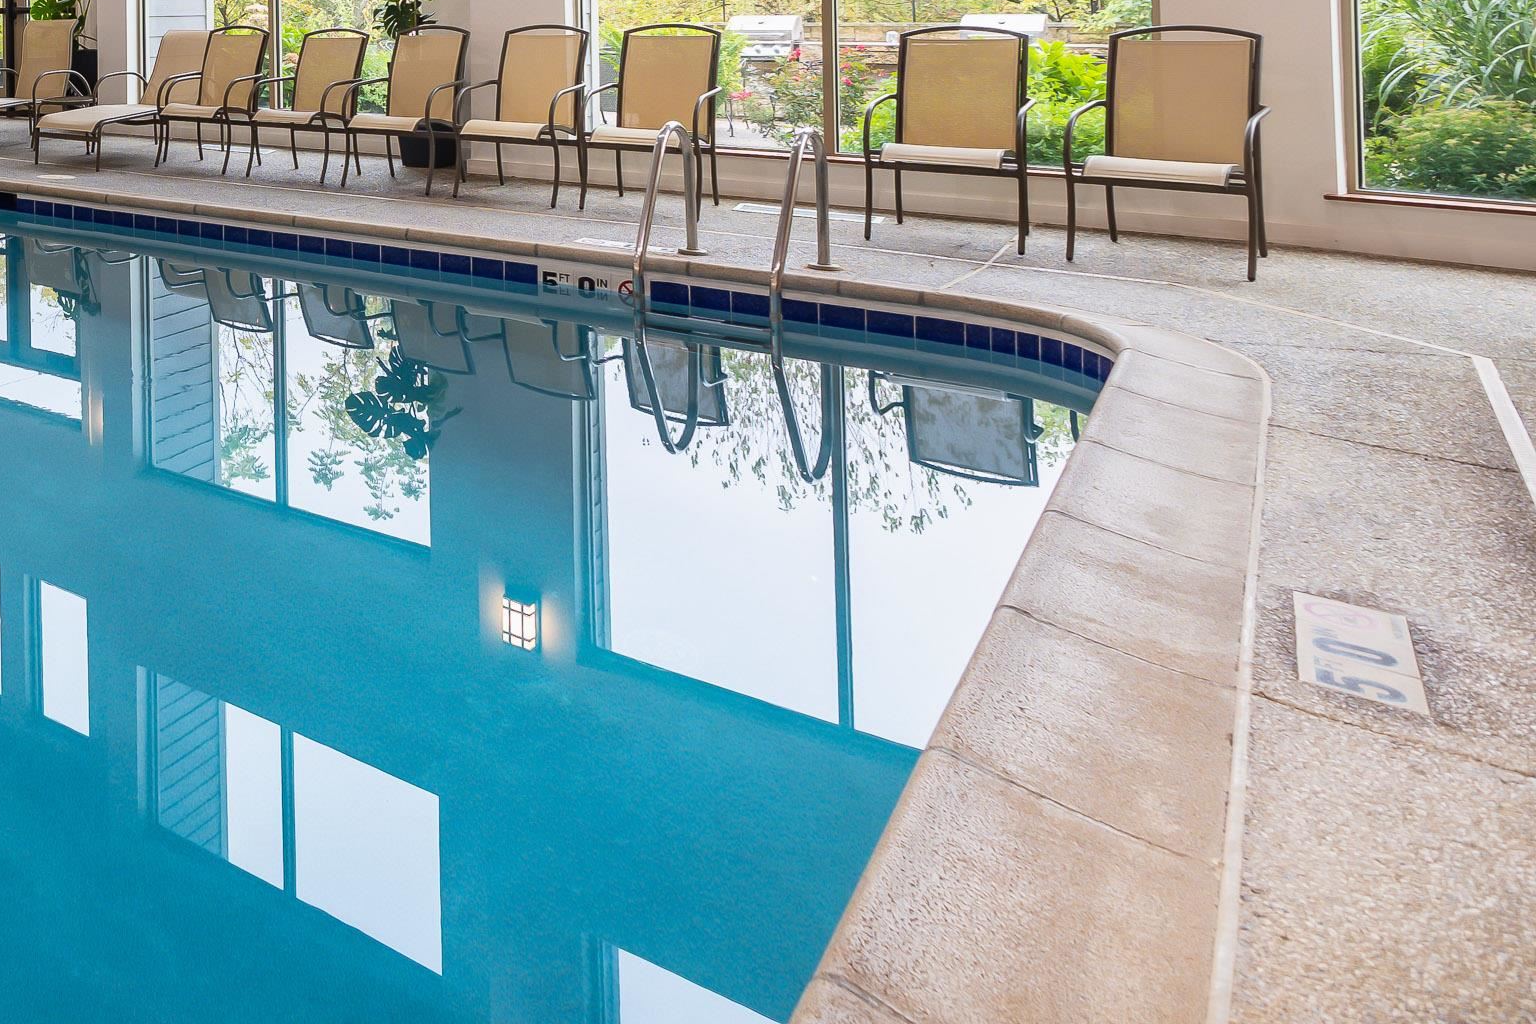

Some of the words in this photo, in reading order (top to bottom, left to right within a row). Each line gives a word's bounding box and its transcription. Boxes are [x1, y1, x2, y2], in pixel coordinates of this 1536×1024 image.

[543, 271, 559, 286] 5
[559, 274, 570, 282] FT
[597, 279, 608, 288] IN
[1311, 637, 1398, 666] 0
[1315, 667, 1408, 703] 5
